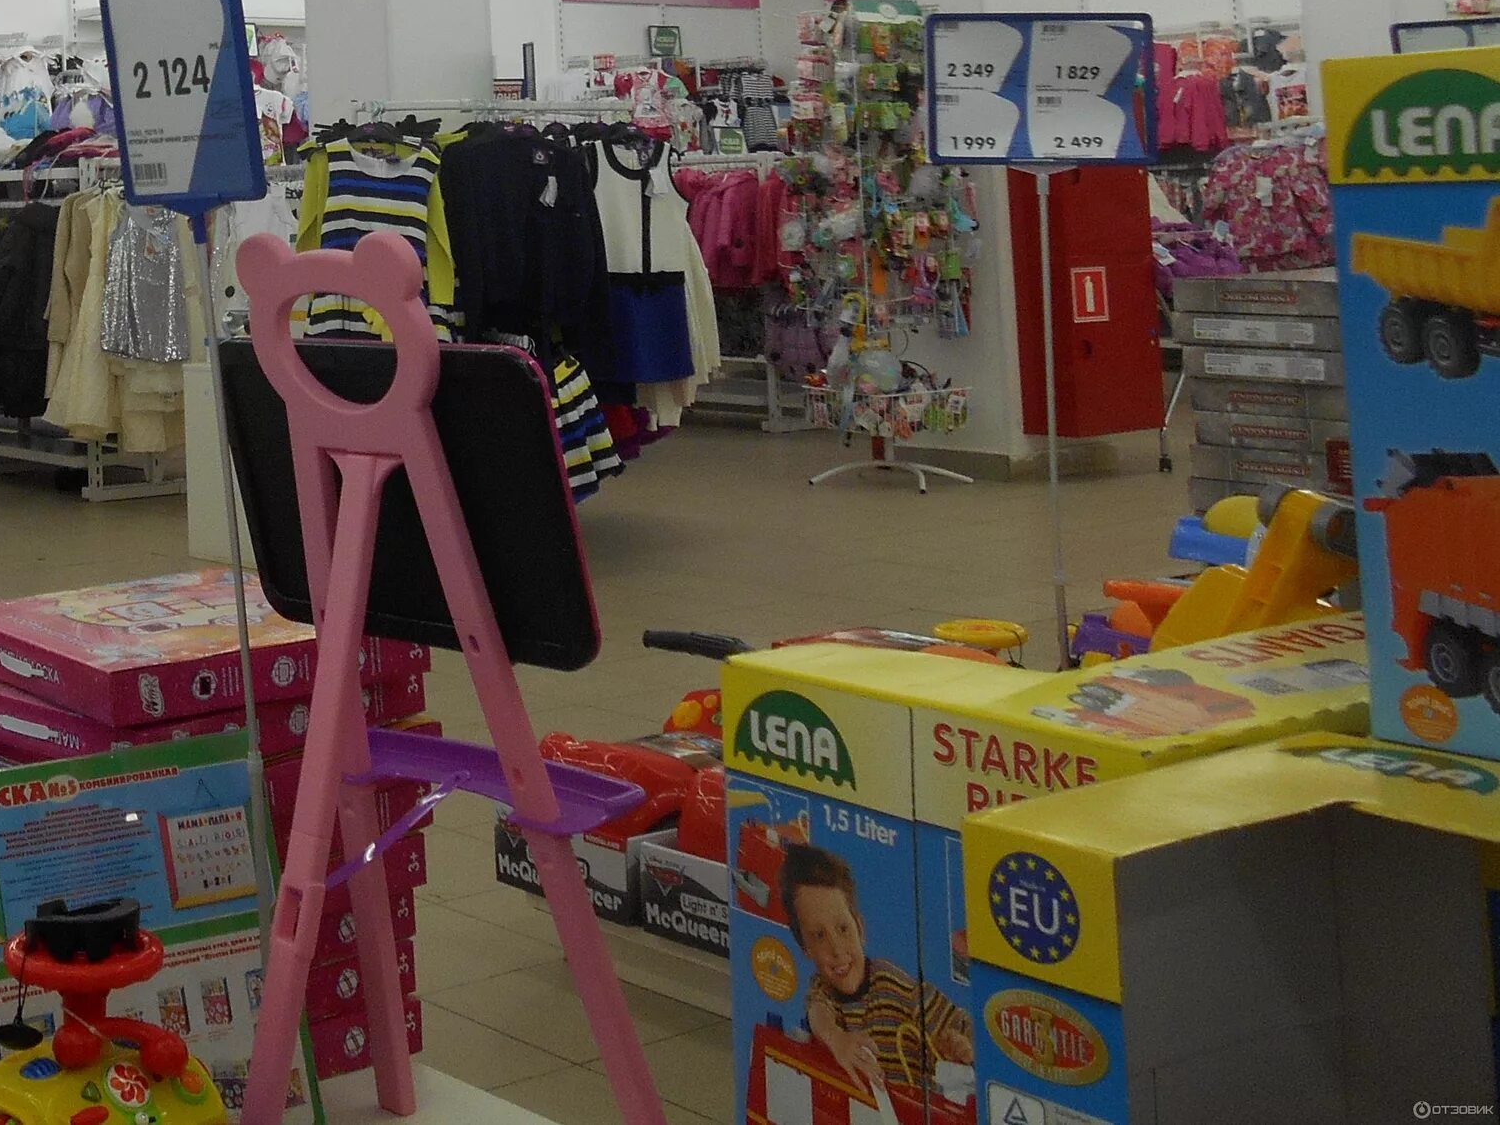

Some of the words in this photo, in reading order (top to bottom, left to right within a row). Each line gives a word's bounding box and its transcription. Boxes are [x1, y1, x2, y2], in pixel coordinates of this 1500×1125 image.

[132, 61, 152, 99] 2
[158, 54, 211, 97] 124
[947, 63, 957, 78] 2
[962, 63, 995, 78] 349
[1055, 65, 1062, 79] 1
[1067, 65, 1101, 81] 829
[950, 136, 958, 150] 1
[964, 136, 997, 150] 999
[1053, 136, 1065, 149] 2
[1070, 136, 1104, 149] 499
[749, 708, 839, 772] LENA
[932, 721, 1100, 791] STARKE
[46, 778, 79, 801] №5
[78, 766, 180, 793] КОМБИНИРОВАННАЯ
[823, 803, 849, 833] 1,5
[855, 812, 899, 846] Liter
[408, 851, 421, 873] 3+
[497, 853, 542, 886] McQu
[397, 896, 409, 918] 3+
[1009, 886, 1060, 935] EU
[645, 902, 729, 948] McQueen
